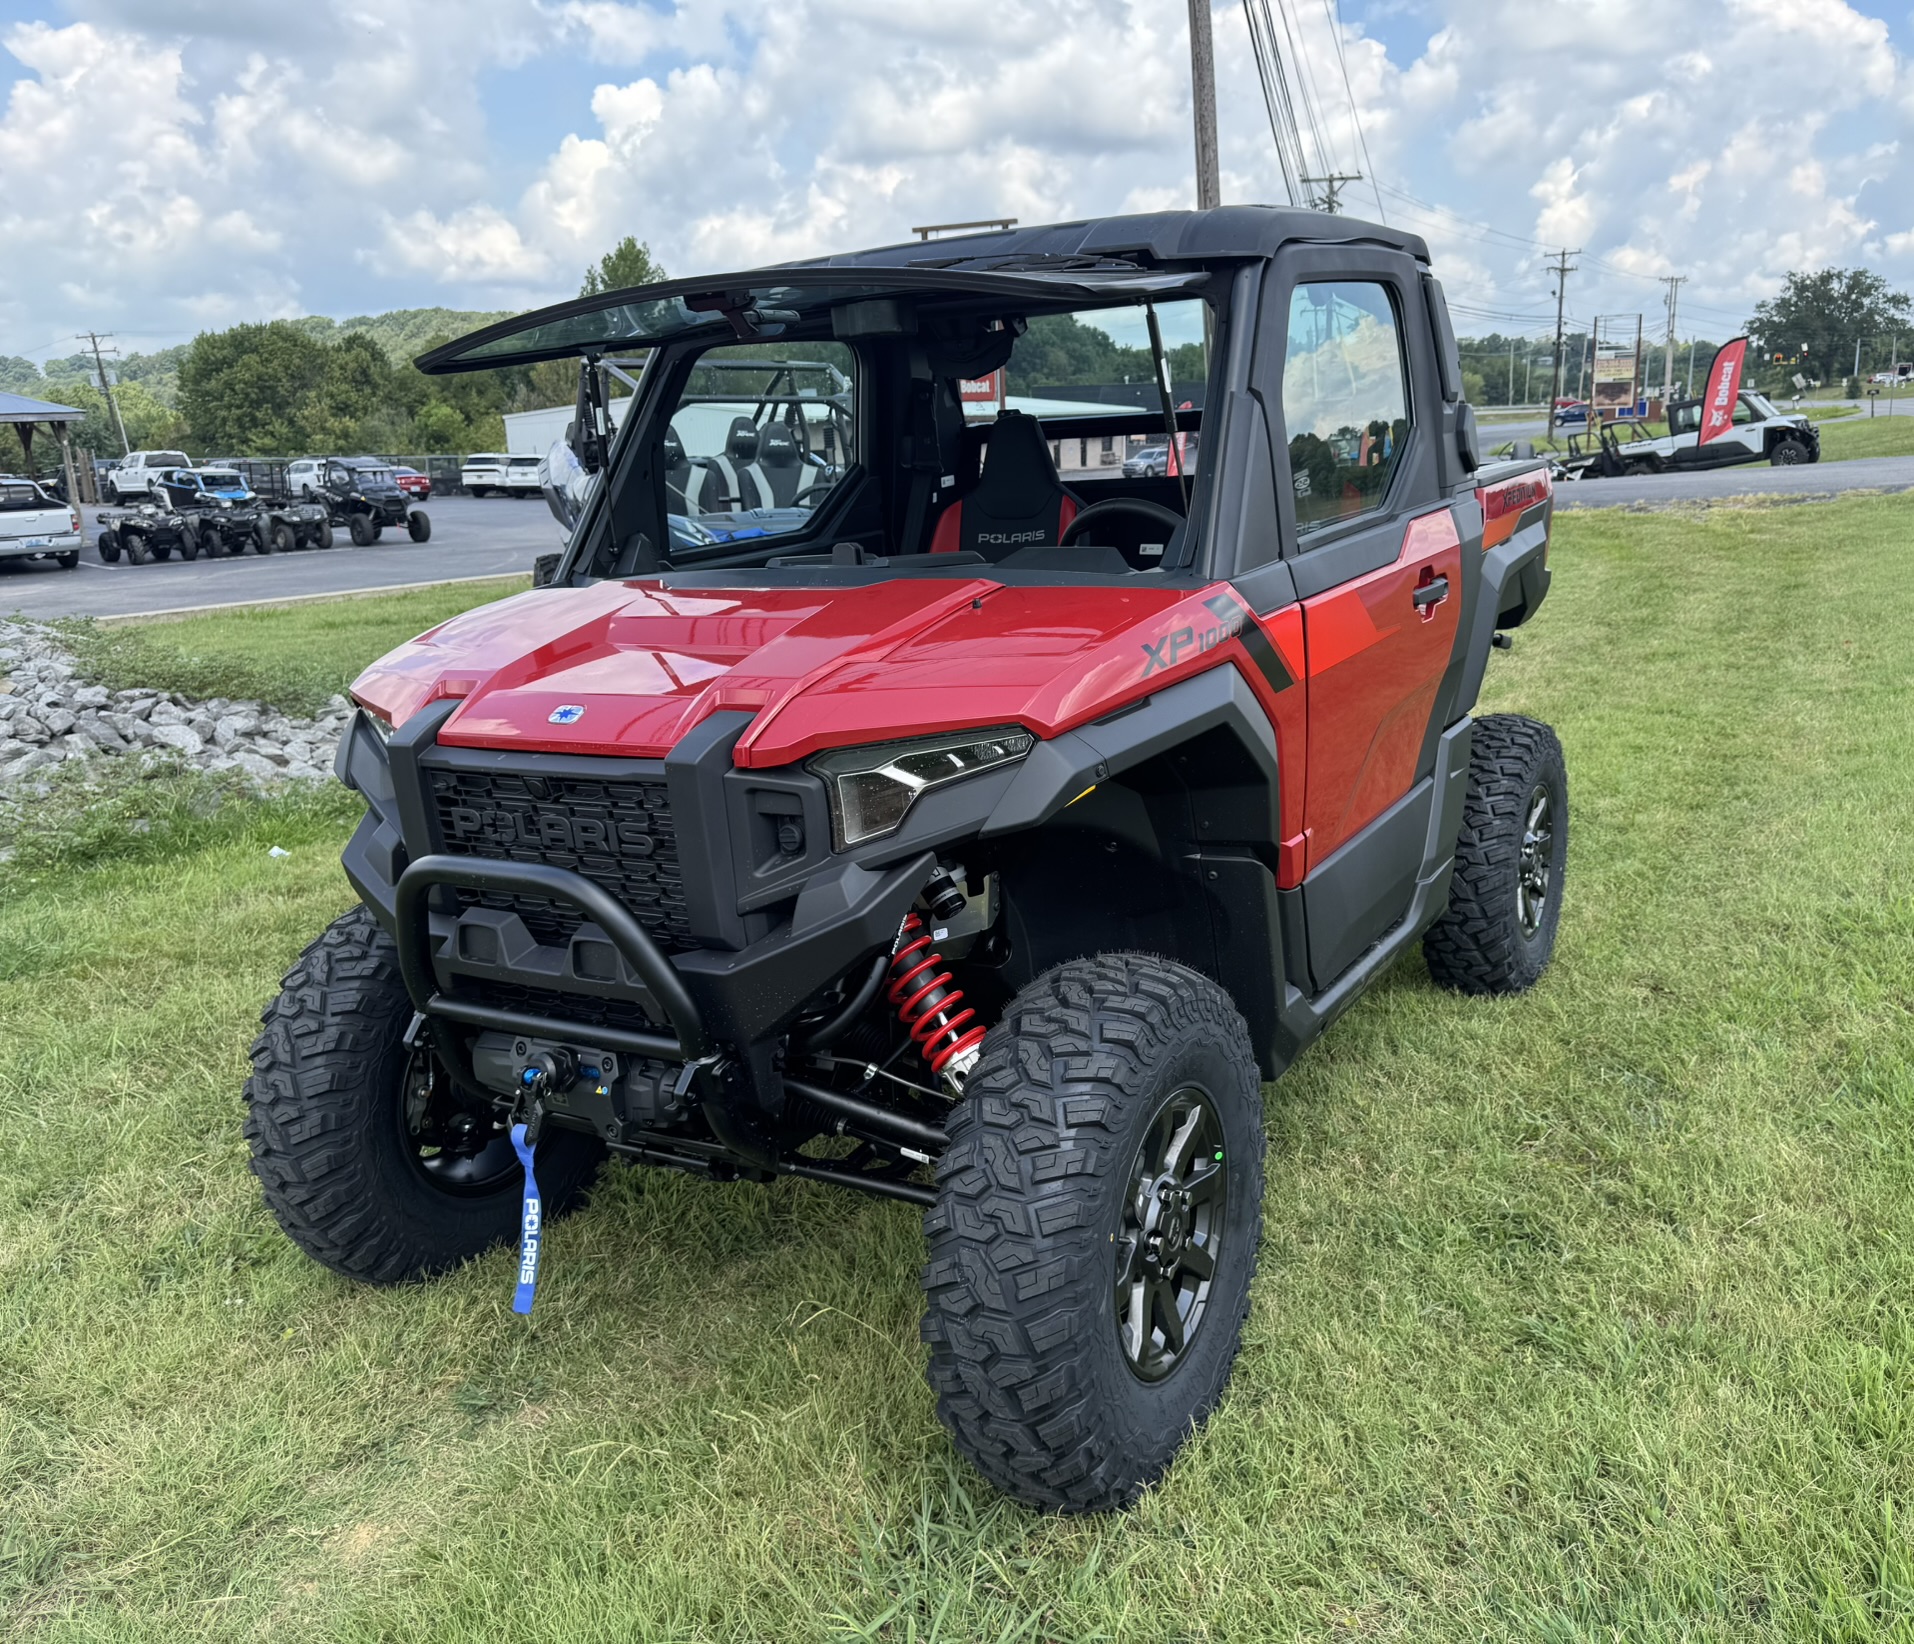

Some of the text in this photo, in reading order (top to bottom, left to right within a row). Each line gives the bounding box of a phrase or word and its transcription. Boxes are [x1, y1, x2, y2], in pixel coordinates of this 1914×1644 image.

[960, 379, 990, 393] Bobcat
[1714, 361, 1735, 406] Bobcat
[977, 529, 1046, 544] POLARIS
[1141, 615, 1243, 678] XP 1000
[450, 807, 655, 856] POLARIS
[520, 1198, 540, 1284] POLARIS
